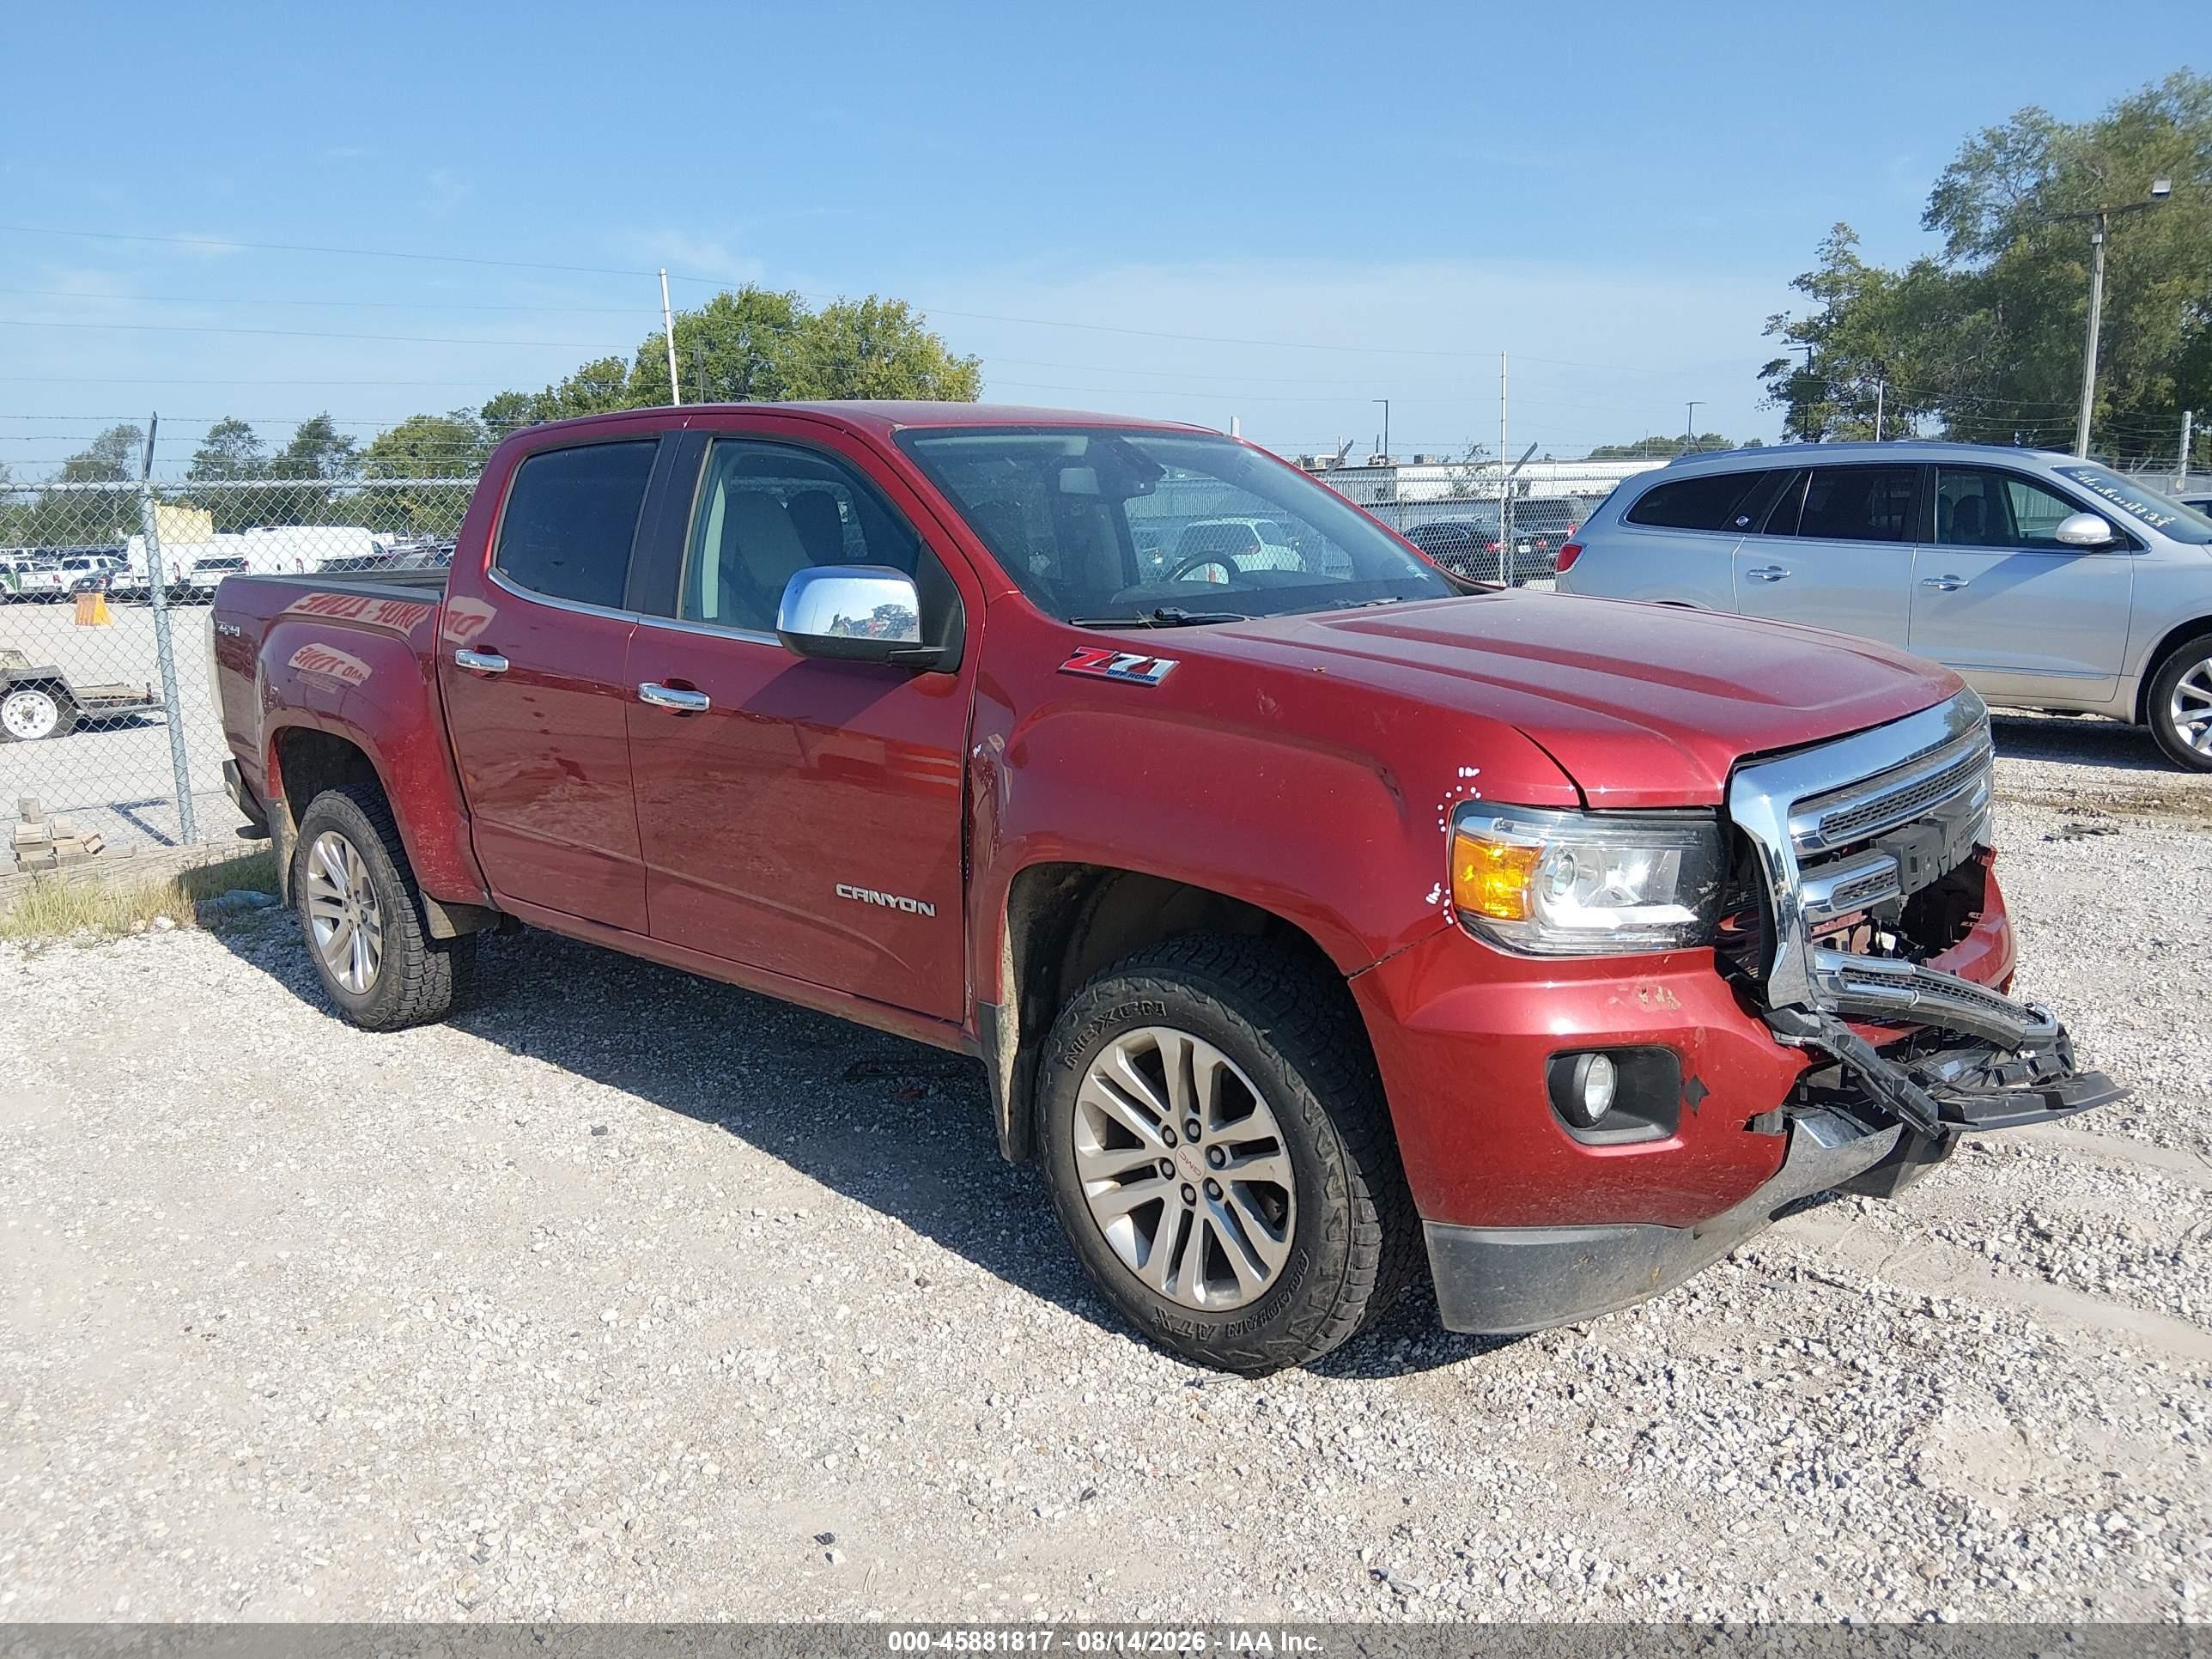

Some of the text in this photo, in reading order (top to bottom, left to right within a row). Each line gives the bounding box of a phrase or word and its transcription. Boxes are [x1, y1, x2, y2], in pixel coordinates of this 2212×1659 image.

[1059, 646, 1180, 684] Z71
[1106, 669, 1158, 683] OFF ROAD
[836, 883, 936, 917] CANYON
[1064, 1000, 1167, 1071] NEXEN
[1178, 1151, 1201, 1176] GMC
[1150, 1248, 1310, 1343] ROADIAN ATX
